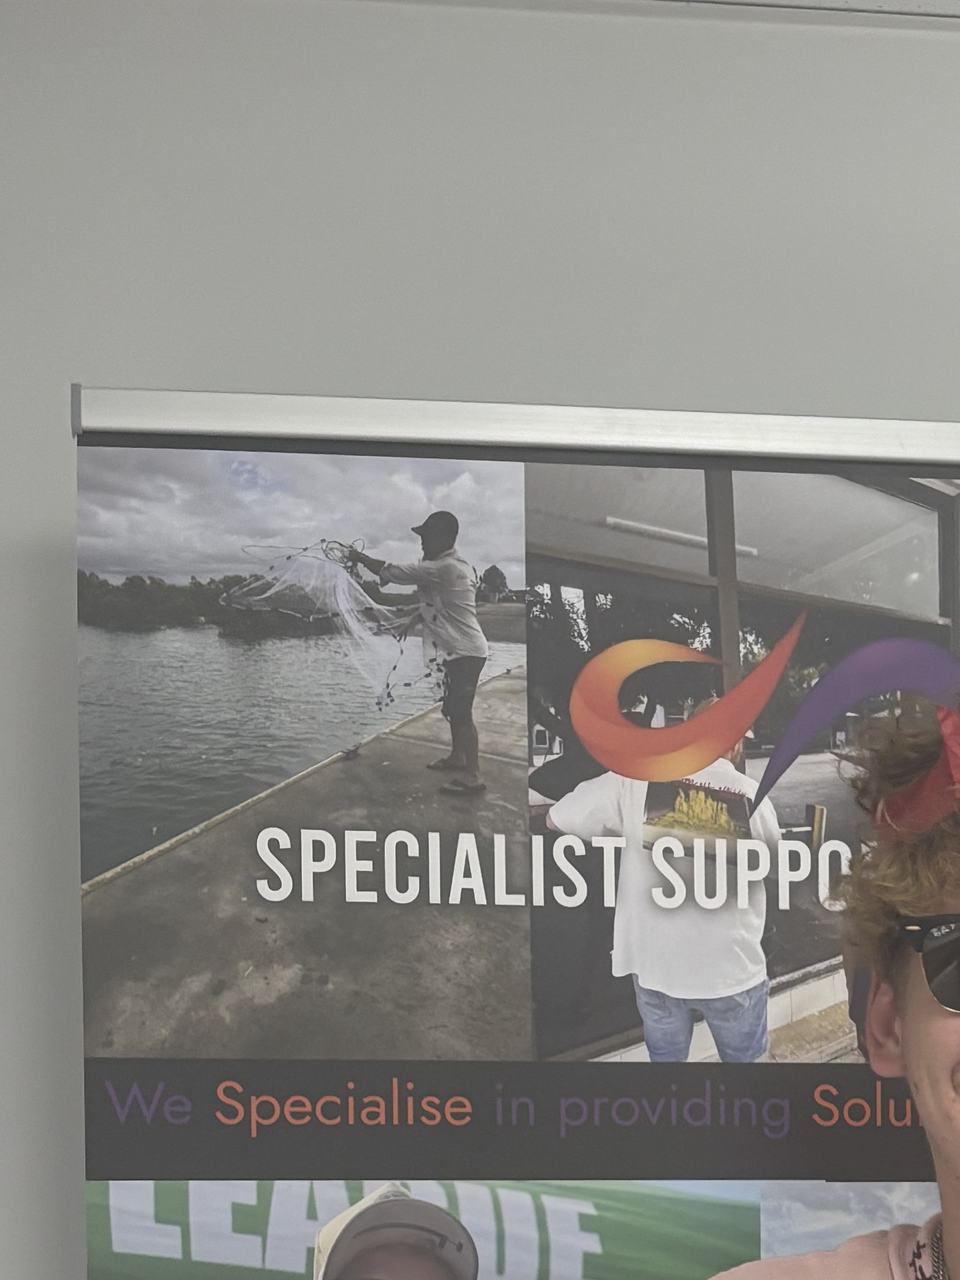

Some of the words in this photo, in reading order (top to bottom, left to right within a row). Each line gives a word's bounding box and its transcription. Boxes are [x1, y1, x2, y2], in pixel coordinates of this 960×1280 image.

[256, 827, 627, 907] SPECIALIST
[651, 836, 876, 913] SUPPO
[104, 1080, 192, 1125] We
[214, 1078, 473, 1138] Specialise
[496, 1083, 536, 1126] in
[559, 1077, 791, 1138] providing
[811, 1079, 924, 1128] Solu
